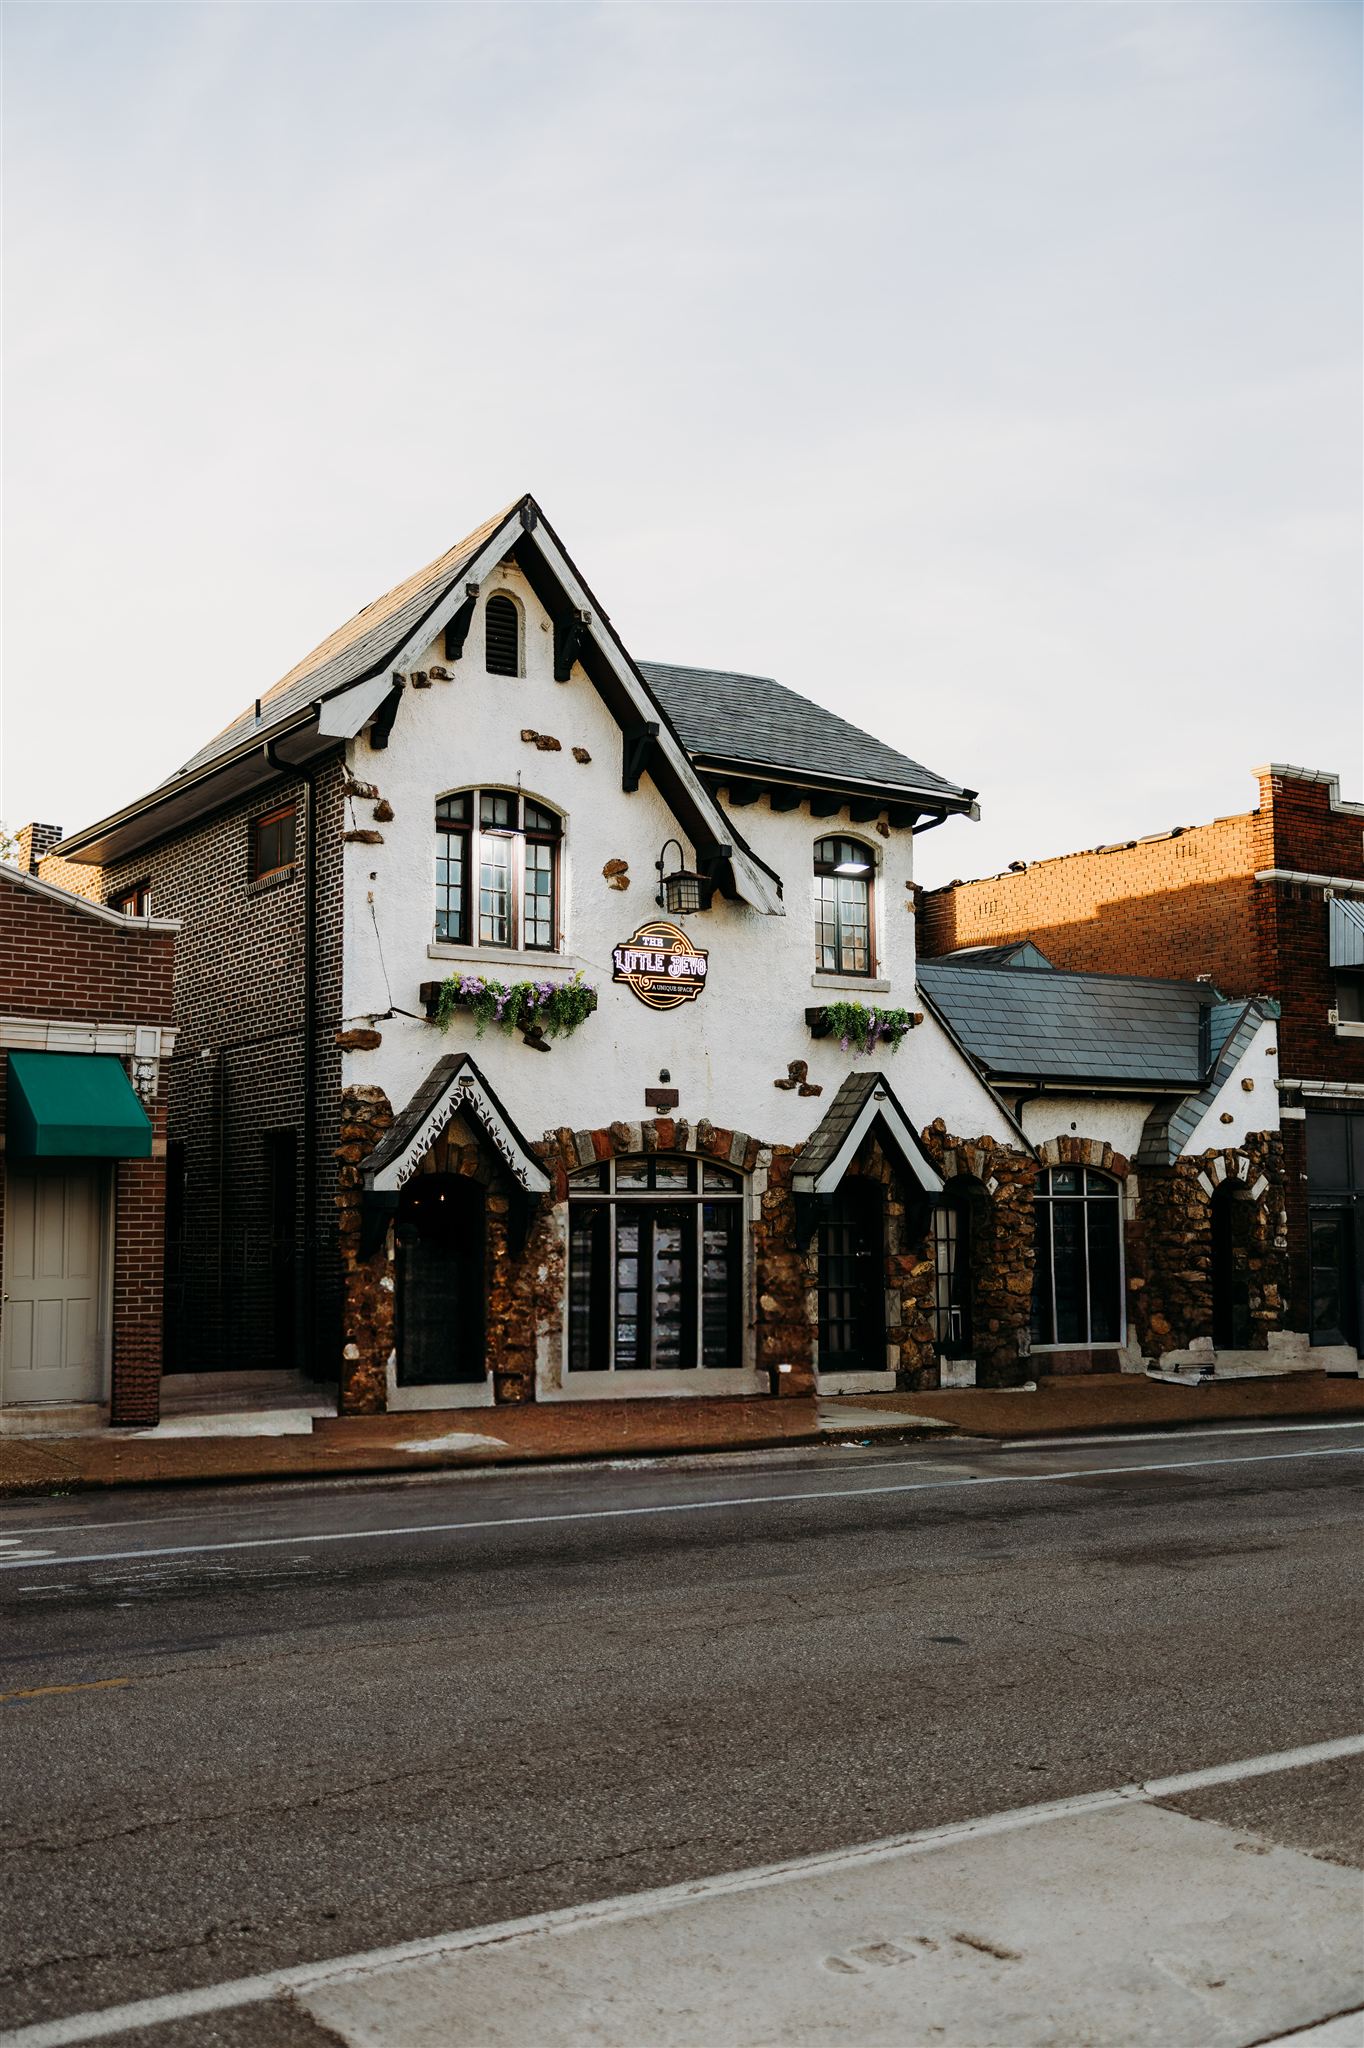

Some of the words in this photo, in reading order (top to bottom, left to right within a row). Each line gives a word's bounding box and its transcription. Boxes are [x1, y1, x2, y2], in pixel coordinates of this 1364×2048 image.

[642, 937, 663, 947] THE
[614, 950, 665, 973] LITTLE
[668, 956, 706, 977] BEVO
